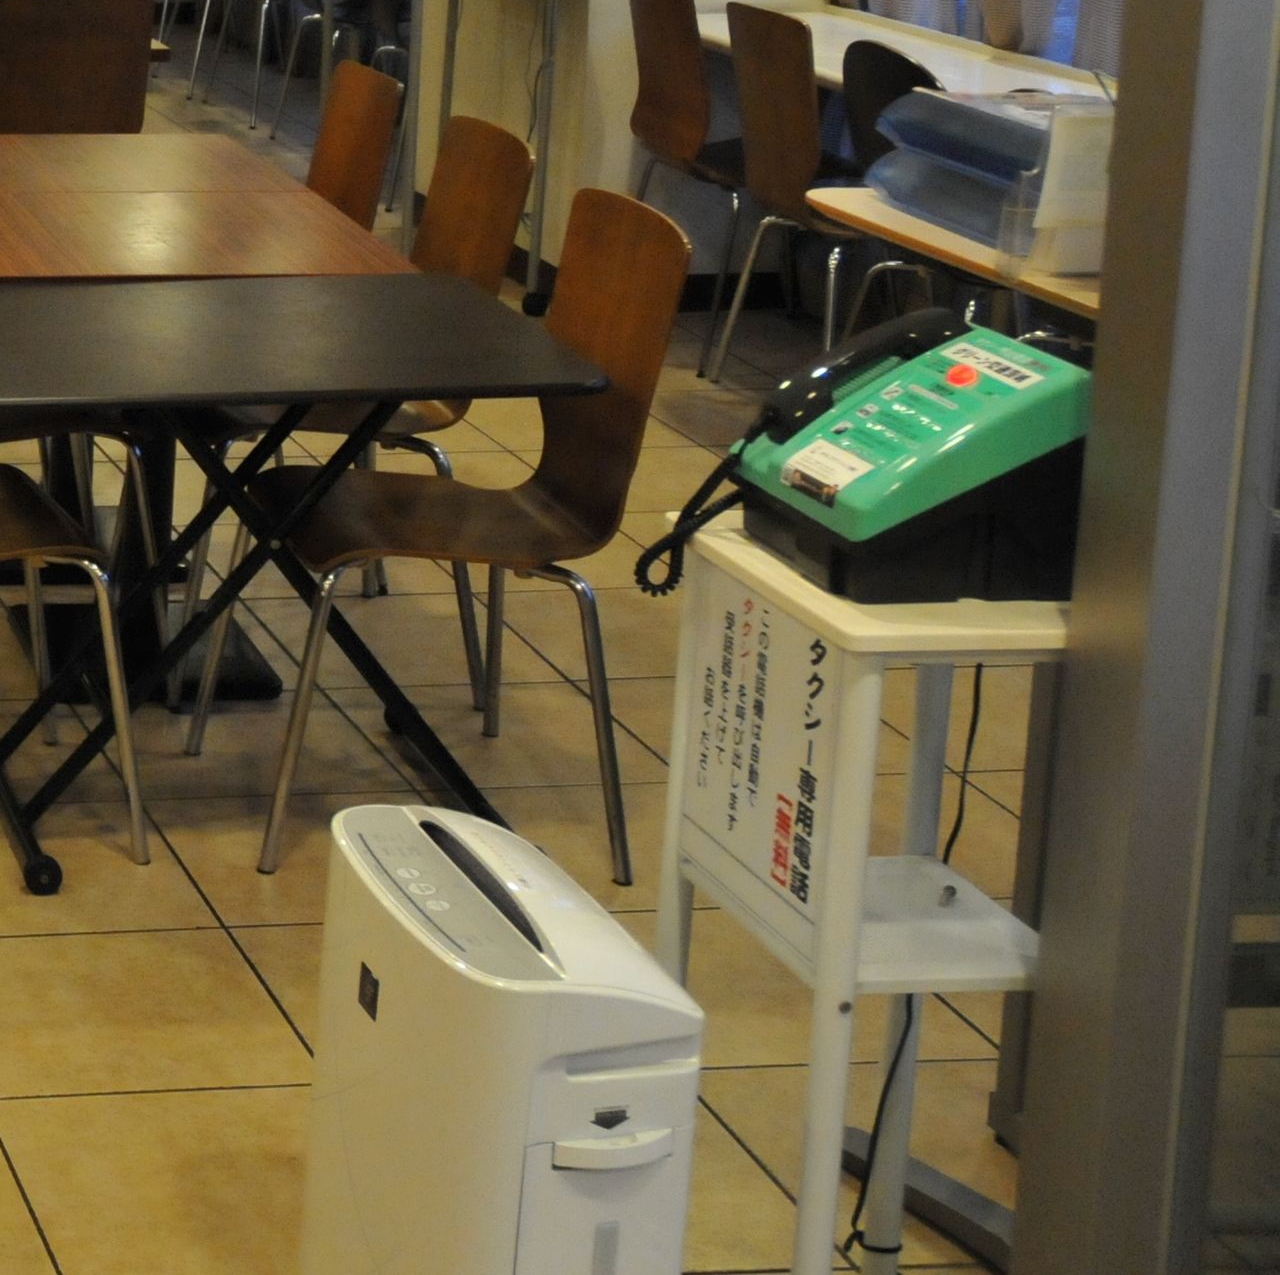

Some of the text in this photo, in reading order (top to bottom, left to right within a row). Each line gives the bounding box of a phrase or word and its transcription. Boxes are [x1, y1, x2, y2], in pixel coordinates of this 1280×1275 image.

[789, 638, 828, 904] タクシー専用電話
